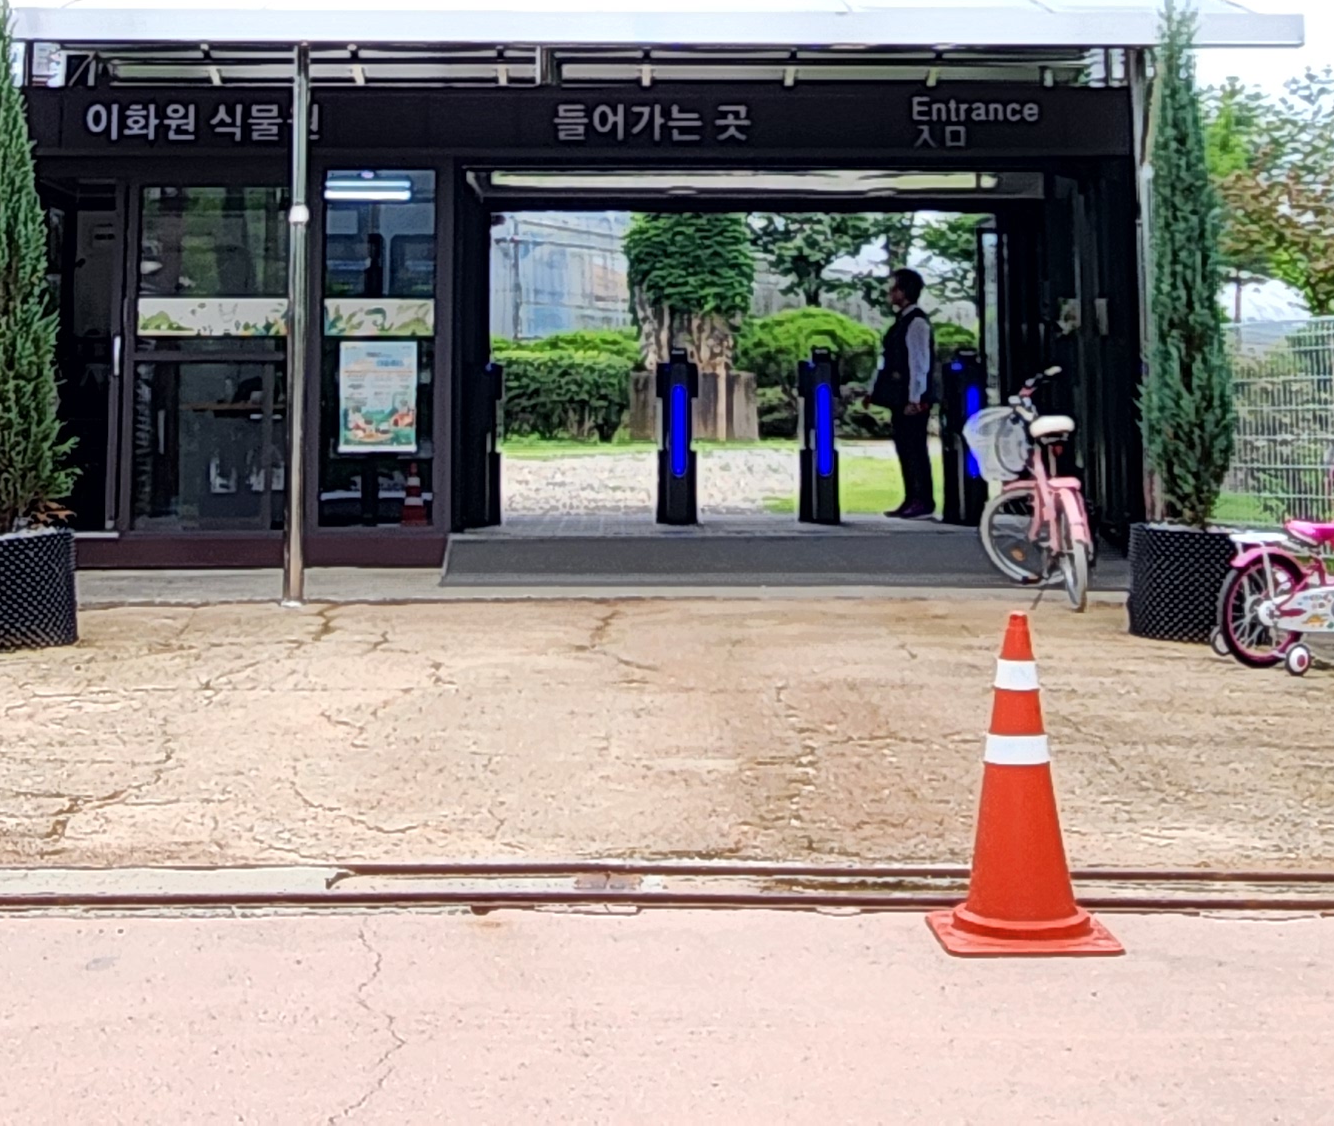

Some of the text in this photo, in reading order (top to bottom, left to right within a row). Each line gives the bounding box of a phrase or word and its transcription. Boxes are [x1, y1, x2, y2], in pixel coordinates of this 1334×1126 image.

[85, 102, 196, 142] 이화원
[553, 103, 752, 142] 들어가는 곳
[910, 96, 1040, 123] Entrance
